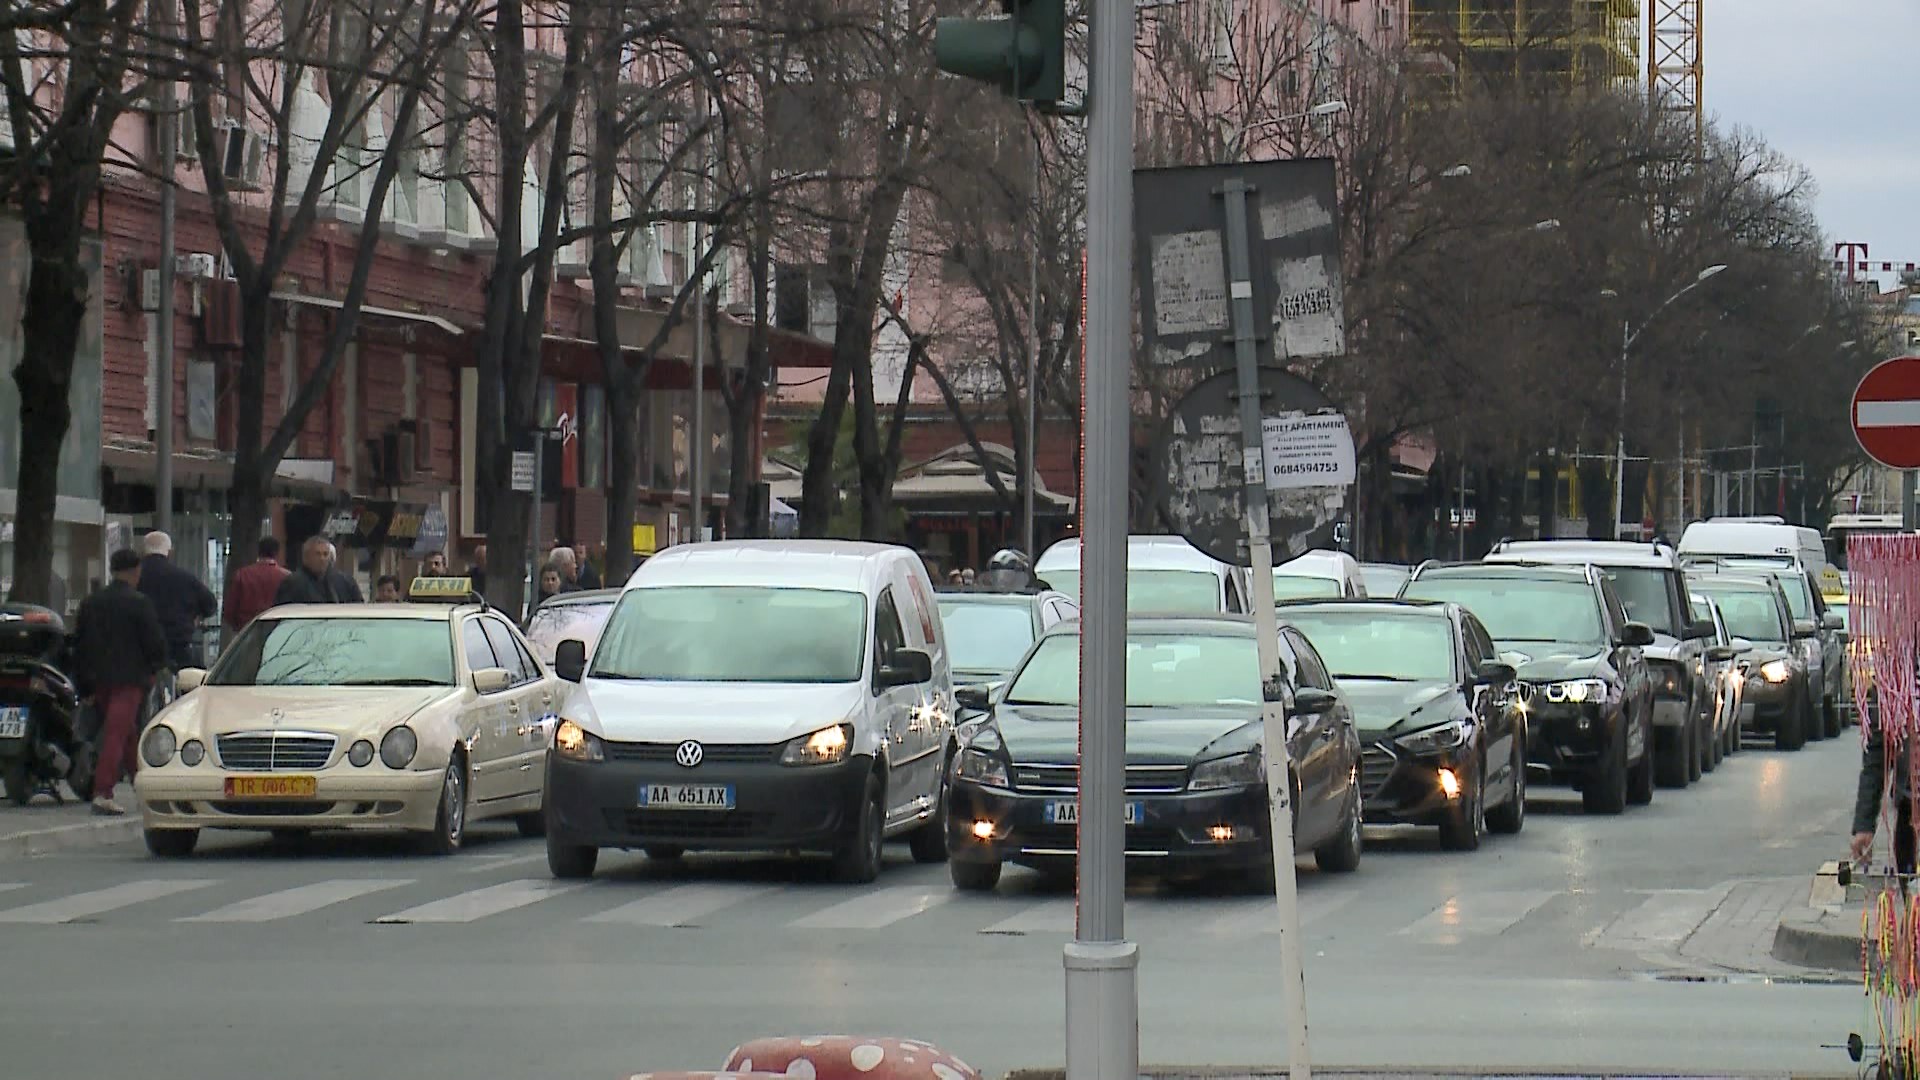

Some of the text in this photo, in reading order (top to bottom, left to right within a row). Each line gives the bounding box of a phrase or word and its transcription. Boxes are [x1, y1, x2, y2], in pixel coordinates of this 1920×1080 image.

[1834, 243, 1868, 284] T
[1290, 421, 1345, 432] APARTAMENT
[1273, 462, 1339, 475] 0684594753
[652, 786, 669, 803] AA
[1058, 804, 1077, 821] AA
